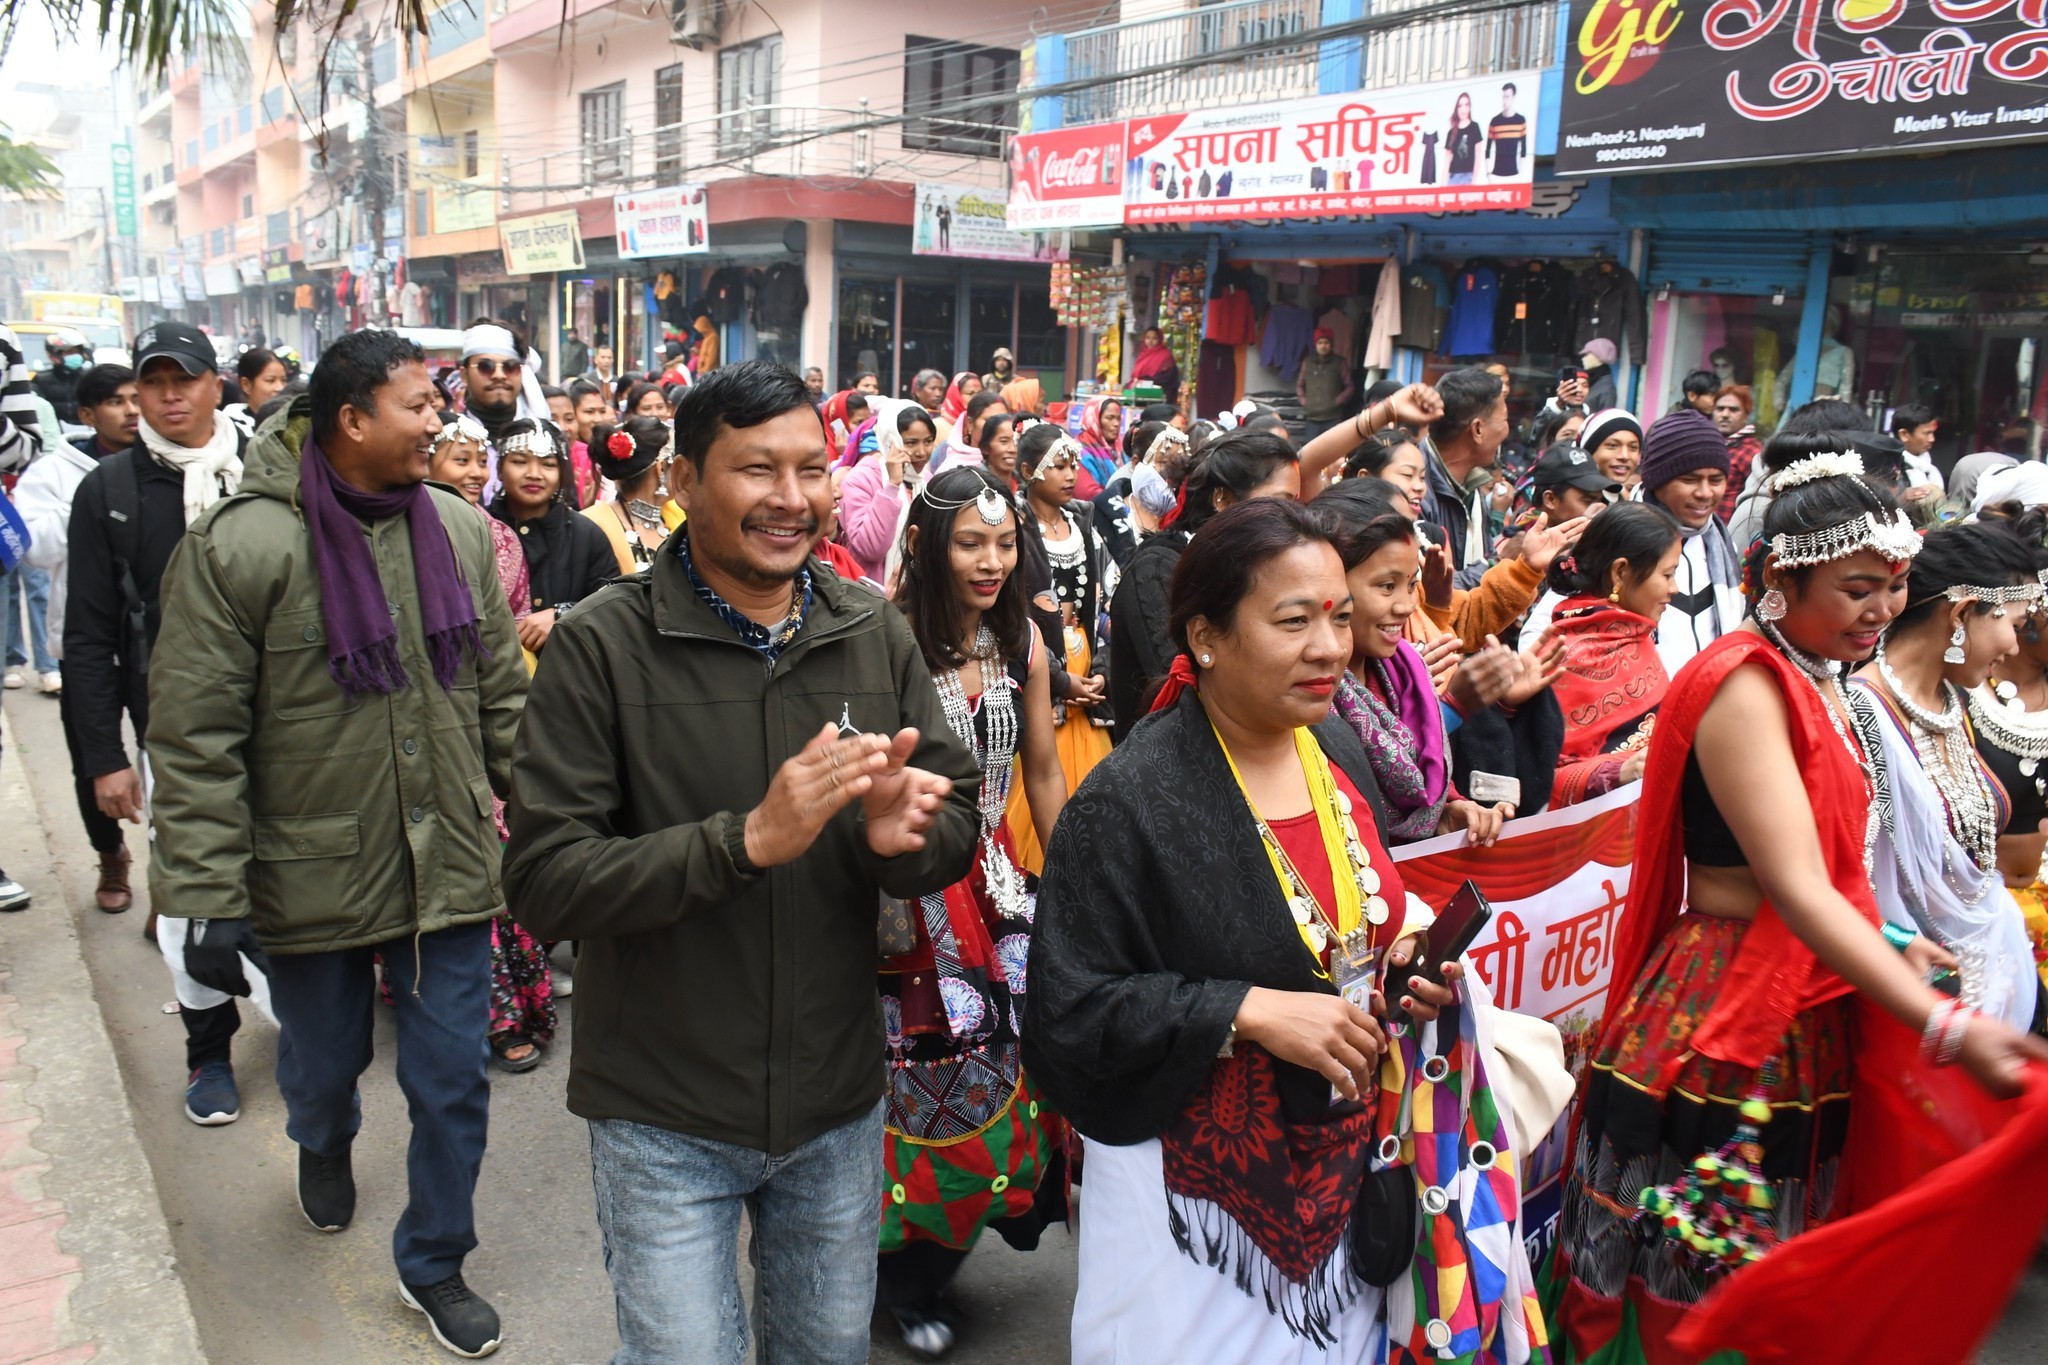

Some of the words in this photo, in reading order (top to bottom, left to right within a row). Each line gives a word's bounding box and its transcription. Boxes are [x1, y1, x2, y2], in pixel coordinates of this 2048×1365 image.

[1565, 129, 1638, 148] NewRoad-2,
[1640, 122, 1706, 142] Nepalgunj
[1893, 114, 1948, 134] Meets
[1951, 110, 1993, 128] Your
[1174, 126, 1282, 172] सपना
[1467, 910, 1531, 1011] घी
[1540, 879, 1629, 992] महो
